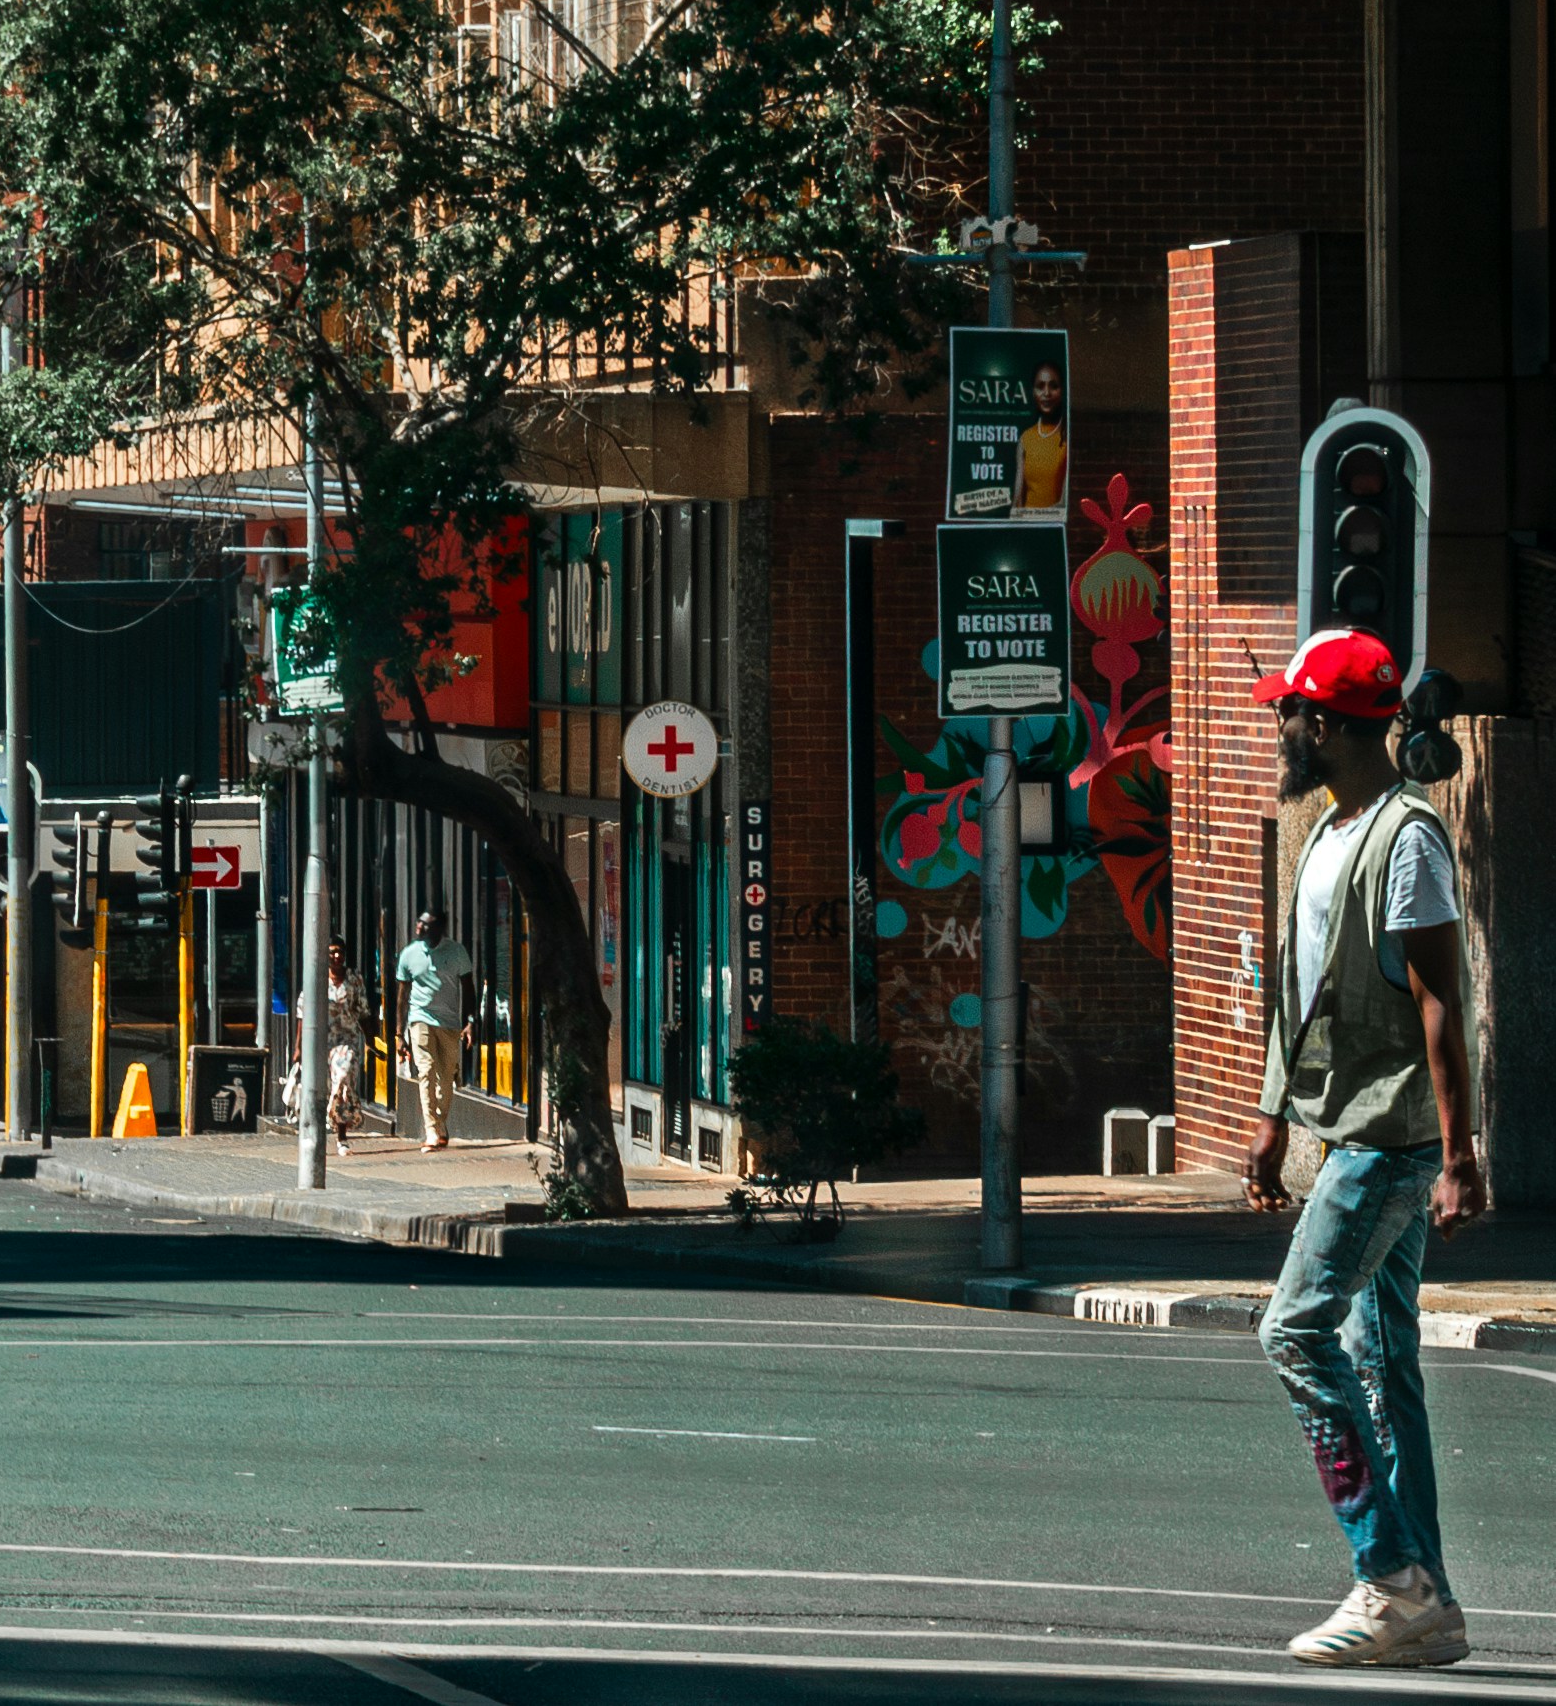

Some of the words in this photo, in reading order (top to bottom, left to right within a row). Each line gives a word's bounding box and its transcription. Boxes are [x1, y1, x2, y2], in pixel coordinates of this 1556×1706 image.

[959, 380, 1028, 404] SARA
[957, 425, 1018, 442] REGISTER
[981, 446, 995, 459] TO
[971, 463, 1004, 481] VOTE
[967, 575, 1040, 598] SARA
[957, 614, 1052, 633] REGISTER
[964, 640, 991, 658] TO
[995, 639, 1046, 658] VOTE
[644, 703, 696, 719] DOCTOR
[642, 776, 700, 794] DENTIST
[747, 807, 764, 1012] SURGERY
